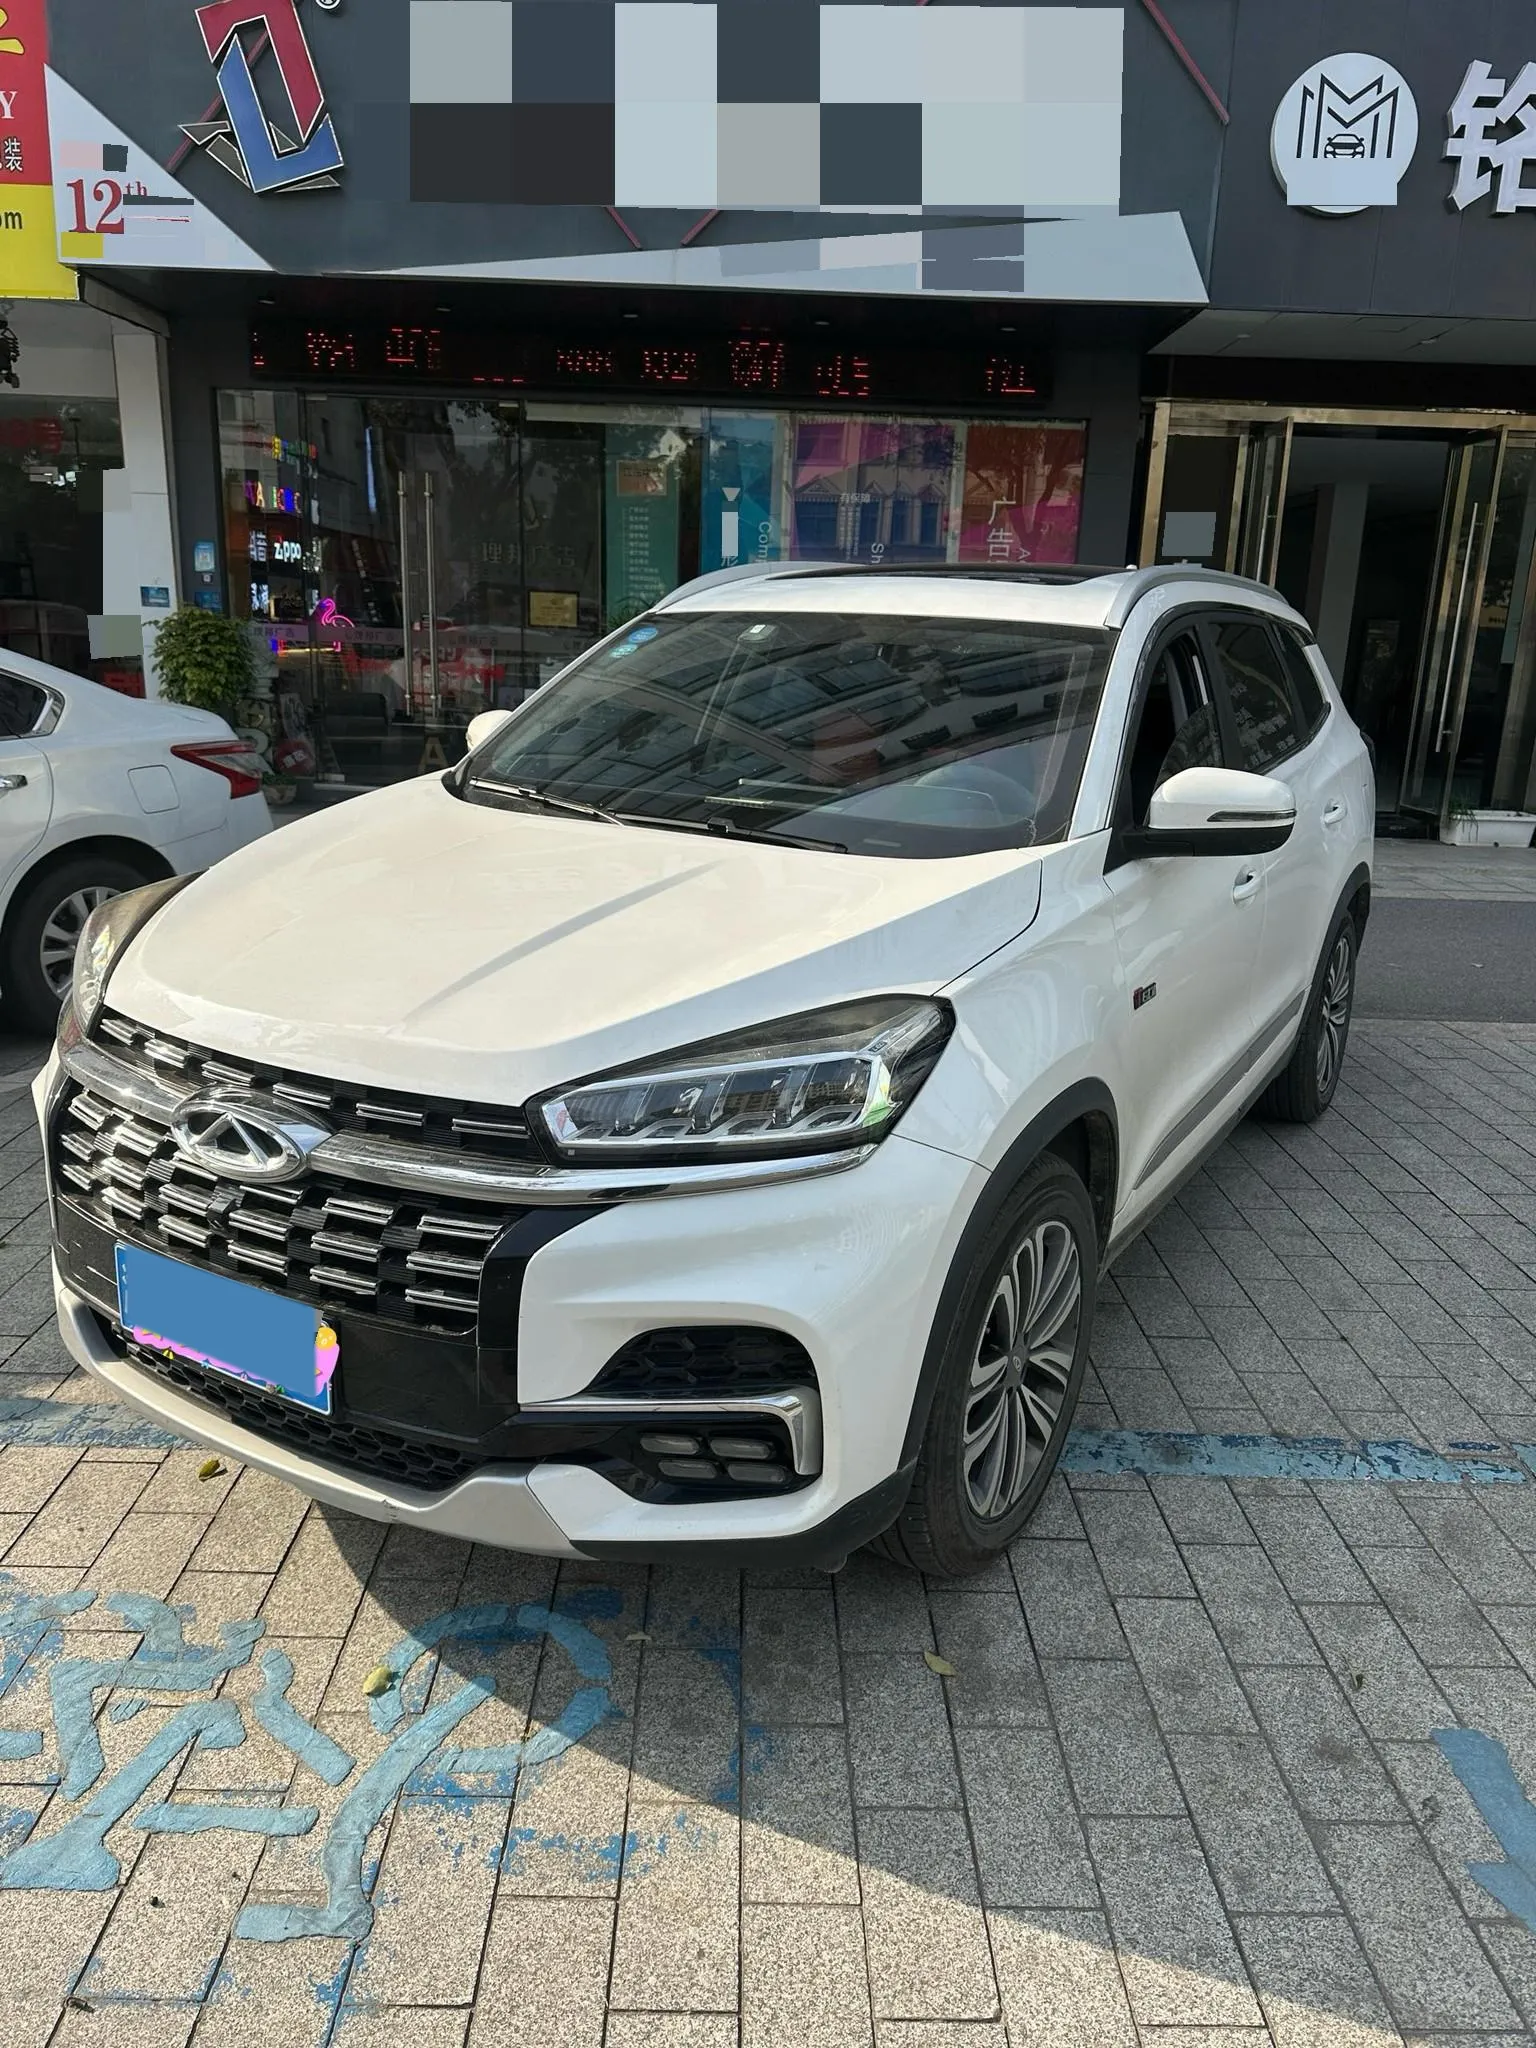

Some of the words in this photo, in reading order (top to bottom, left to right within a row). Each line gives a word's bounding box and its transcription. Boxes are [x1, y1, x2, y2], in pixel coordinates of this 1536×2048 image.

[0, 137, 23, 172] 装
[0, 211, 23, 230] m
[758, 521, 772, 563] Com
[986, 496, 1017, 563] 广告
